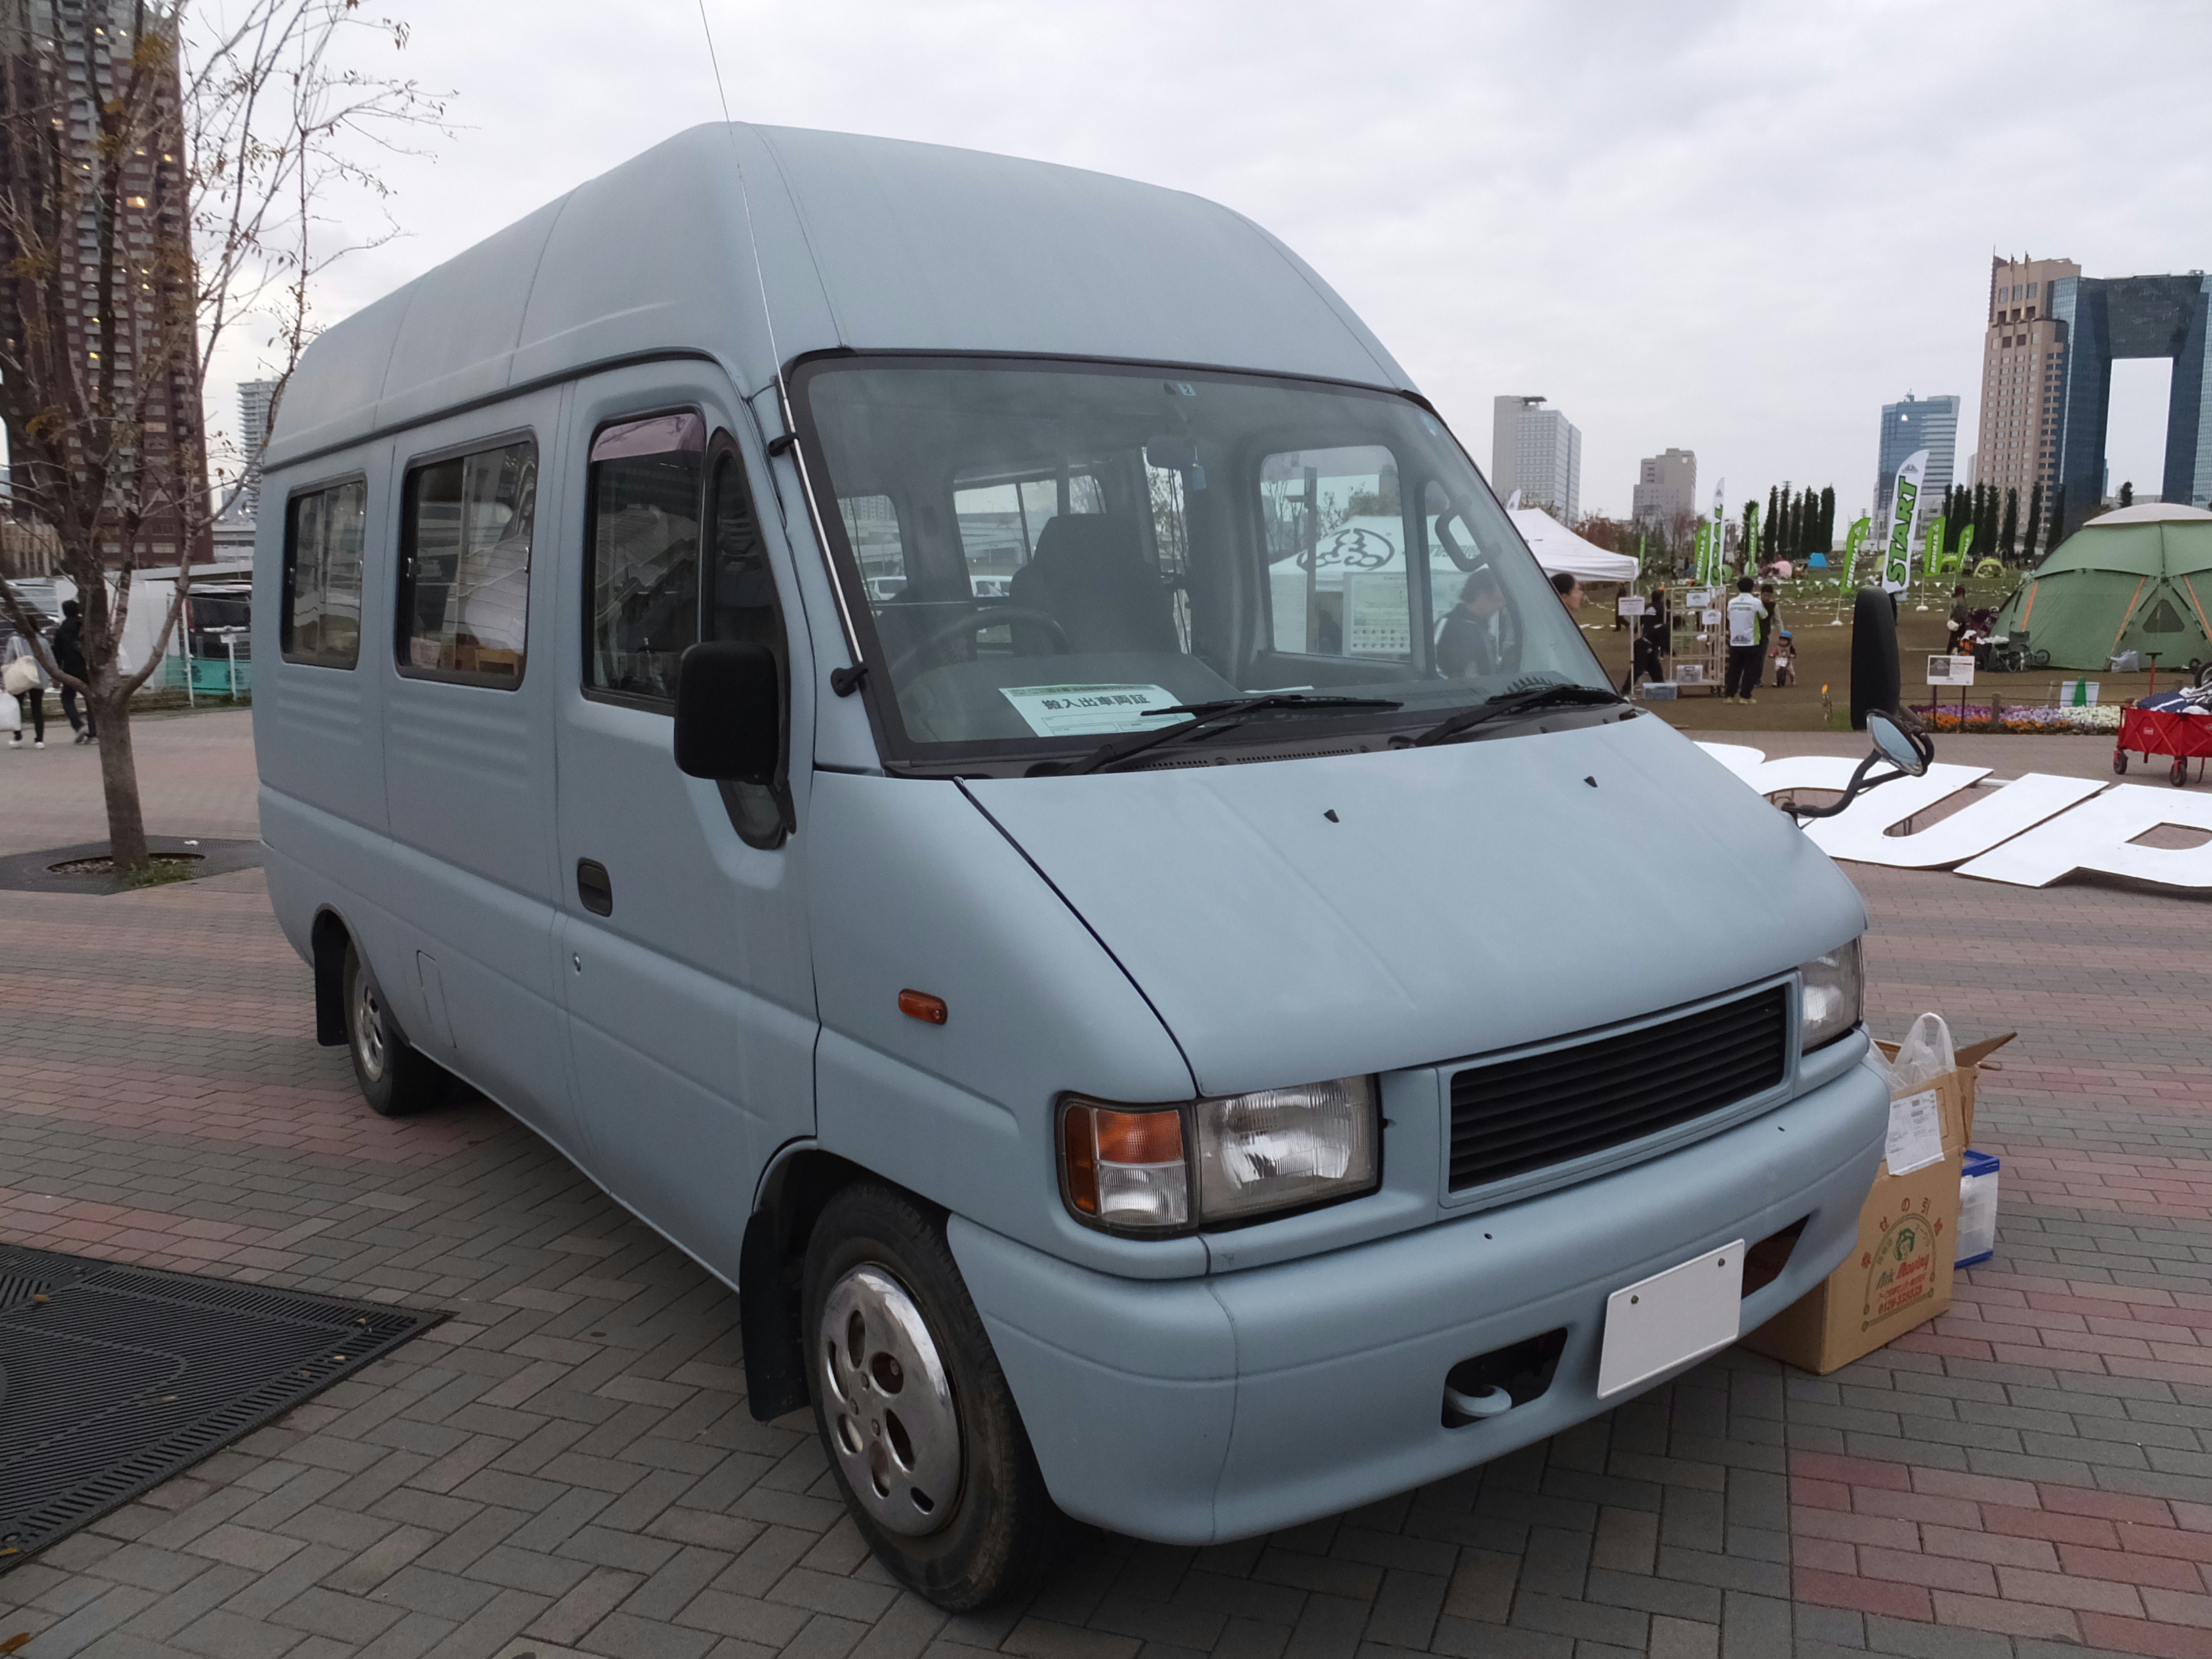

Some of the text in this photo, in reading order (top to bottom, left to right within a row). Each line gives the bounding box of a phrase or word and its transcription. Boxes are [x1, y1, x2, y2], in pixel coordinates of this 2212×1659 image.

[1711, 503, 1723, 587] GOAL
[1887, 476, 1917, 587] START
[1696, 539, 1705, 581] STRIDER
[1846, 538, 1860, 588] STRIDER
[1042, 694, 1151, 710] 搬入出車両証
[1896, 1254, 1930, 1281] Moving
